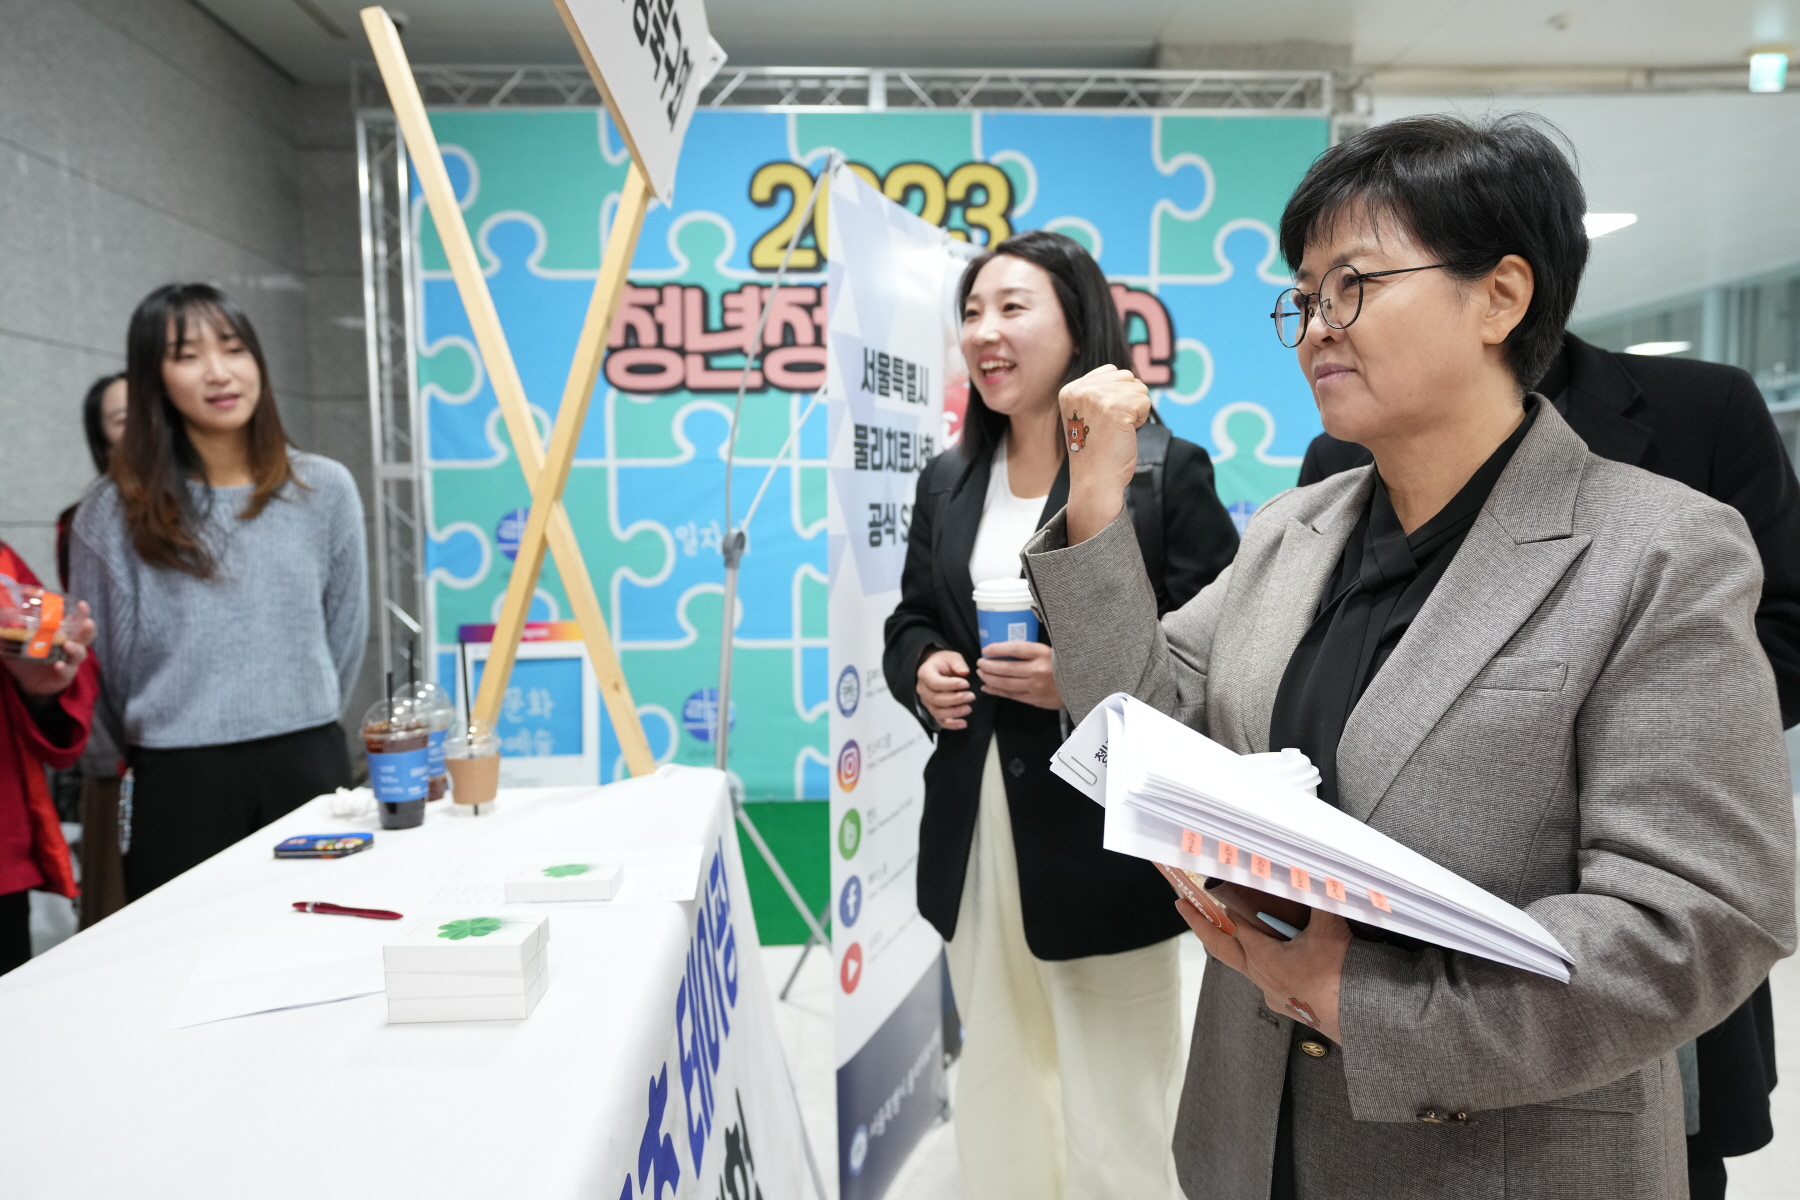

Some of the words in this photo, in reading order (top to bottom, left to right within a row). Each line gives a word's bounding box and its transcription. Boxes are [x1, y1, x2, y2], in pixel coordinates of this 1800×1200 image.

[861, 346, 930, 406] 서울특별시
[675, 519, 750, 557] 일자
[868, 503, 896, 547] 공식
